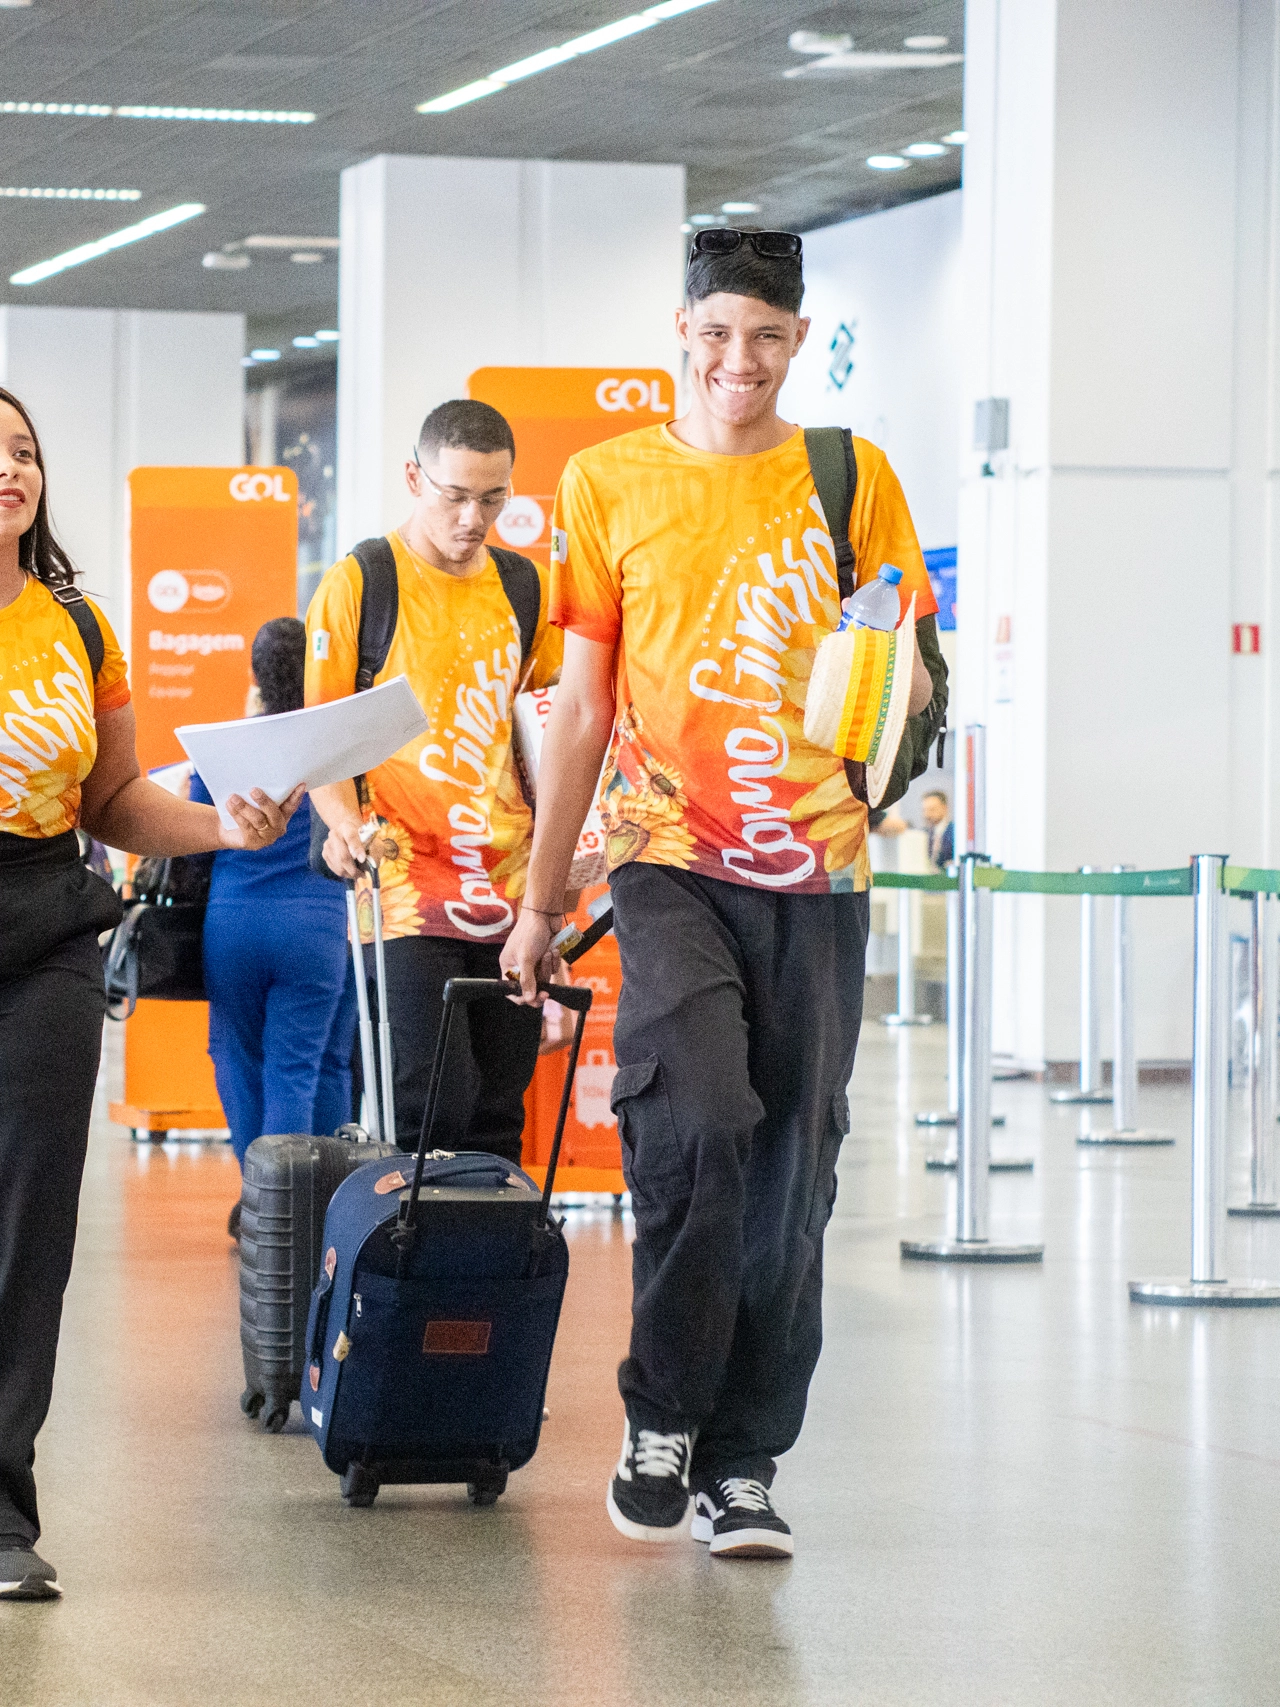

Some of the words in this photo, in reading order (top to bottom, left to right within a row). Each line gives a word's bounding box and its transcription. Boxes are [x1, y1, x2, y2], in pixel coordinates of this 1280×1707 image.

[596, 378, 670, 412] GOL
[228, 473, 291, 502] GOL
[701, 536, 755, 647] ESPETACULO
[764, 507, 803, 530] 2025
[149, 631, 245, 656] Bagagem
[13, 652, 49, 672] 2025
[722, 716, 816, 887] Como
[444, 797, 514, 938] Como
